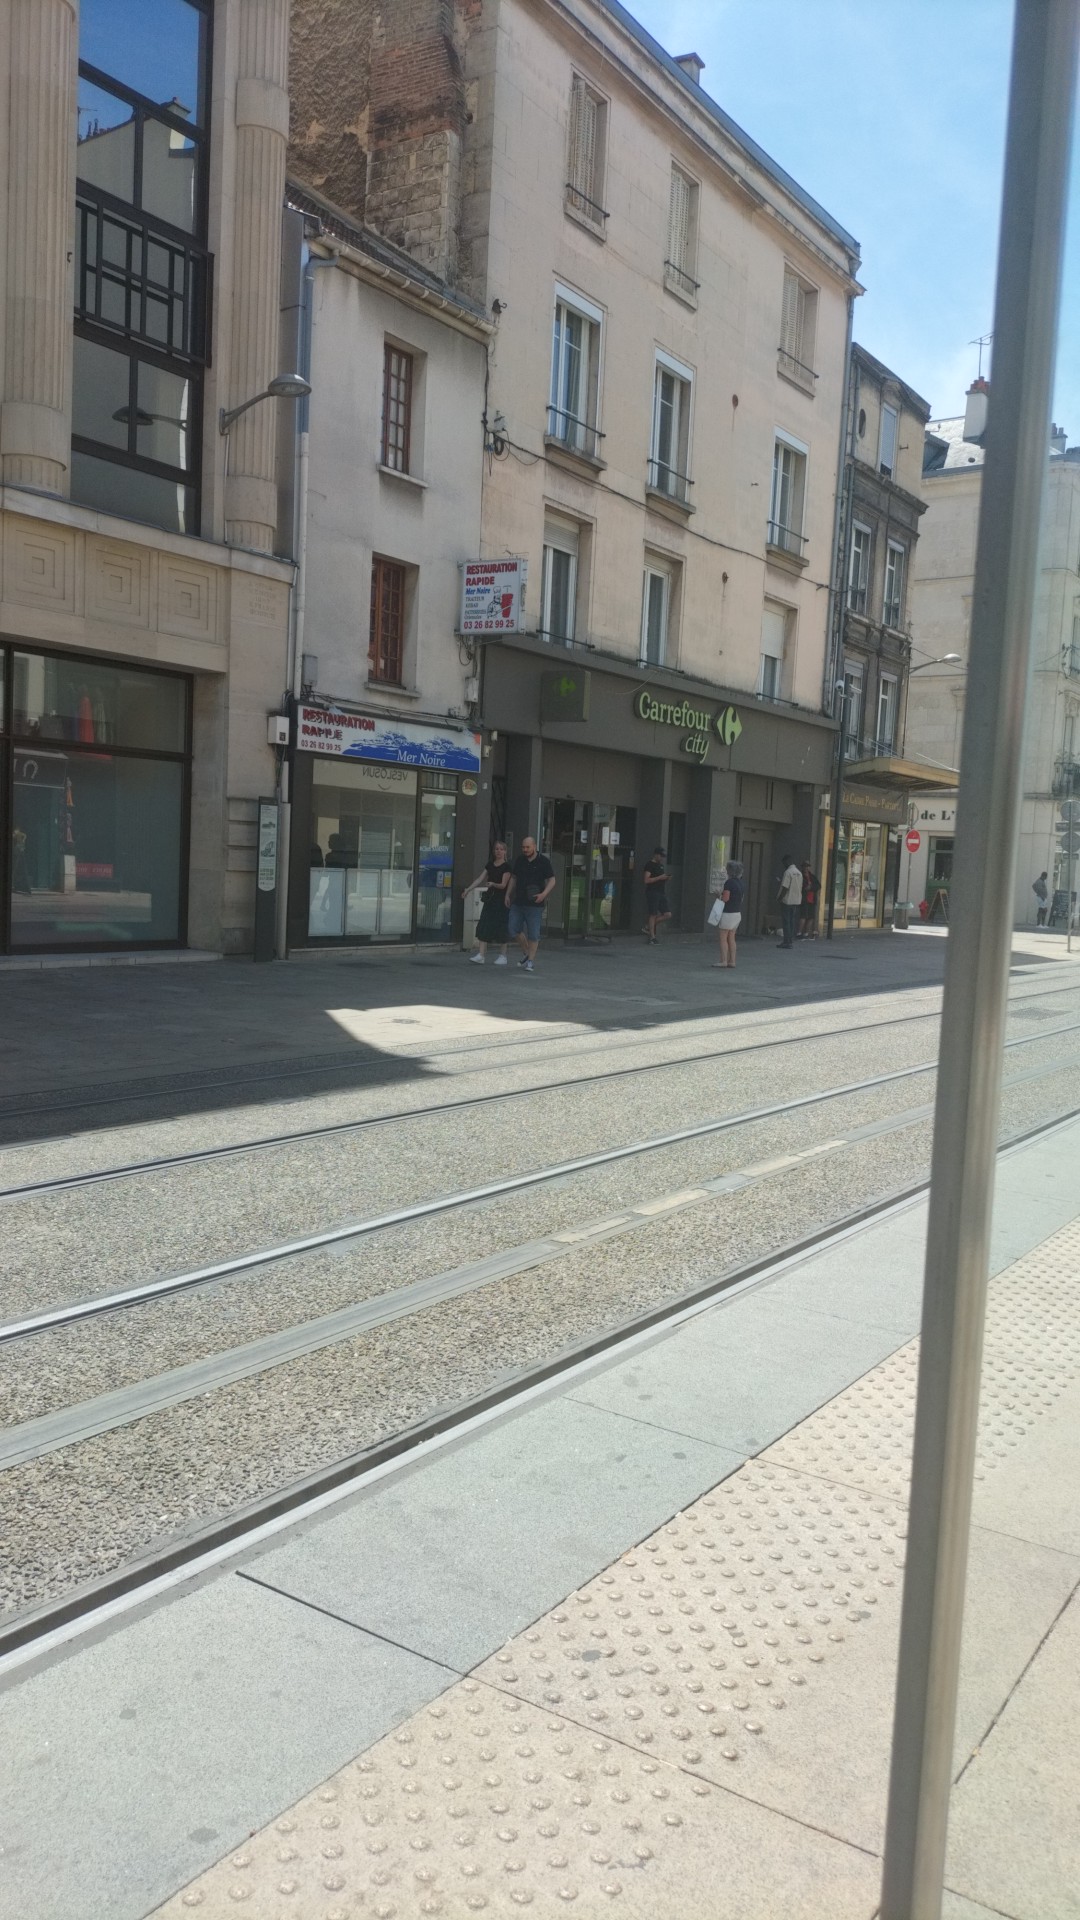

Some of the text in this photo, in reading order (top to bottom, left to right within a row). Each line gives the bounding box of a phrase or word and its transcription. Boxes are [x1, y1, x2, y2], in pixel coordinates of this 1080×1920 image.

[466, 562, 517, 575] RESTAURATION
[465, 576, 495, 586] RAPIDE
[464, 619, 514, 629] 03 26 82 99 25
[639, 691, 711, 731] Carrefour
[302, 708, 375, 732] RESTAURATION
[301, 739, 341, 752] 03 26 82 99 25
[685, 732, 710, 764] city
[397, 750, 446, 766] Mer Noire
[921, 810, 936, 820] de
